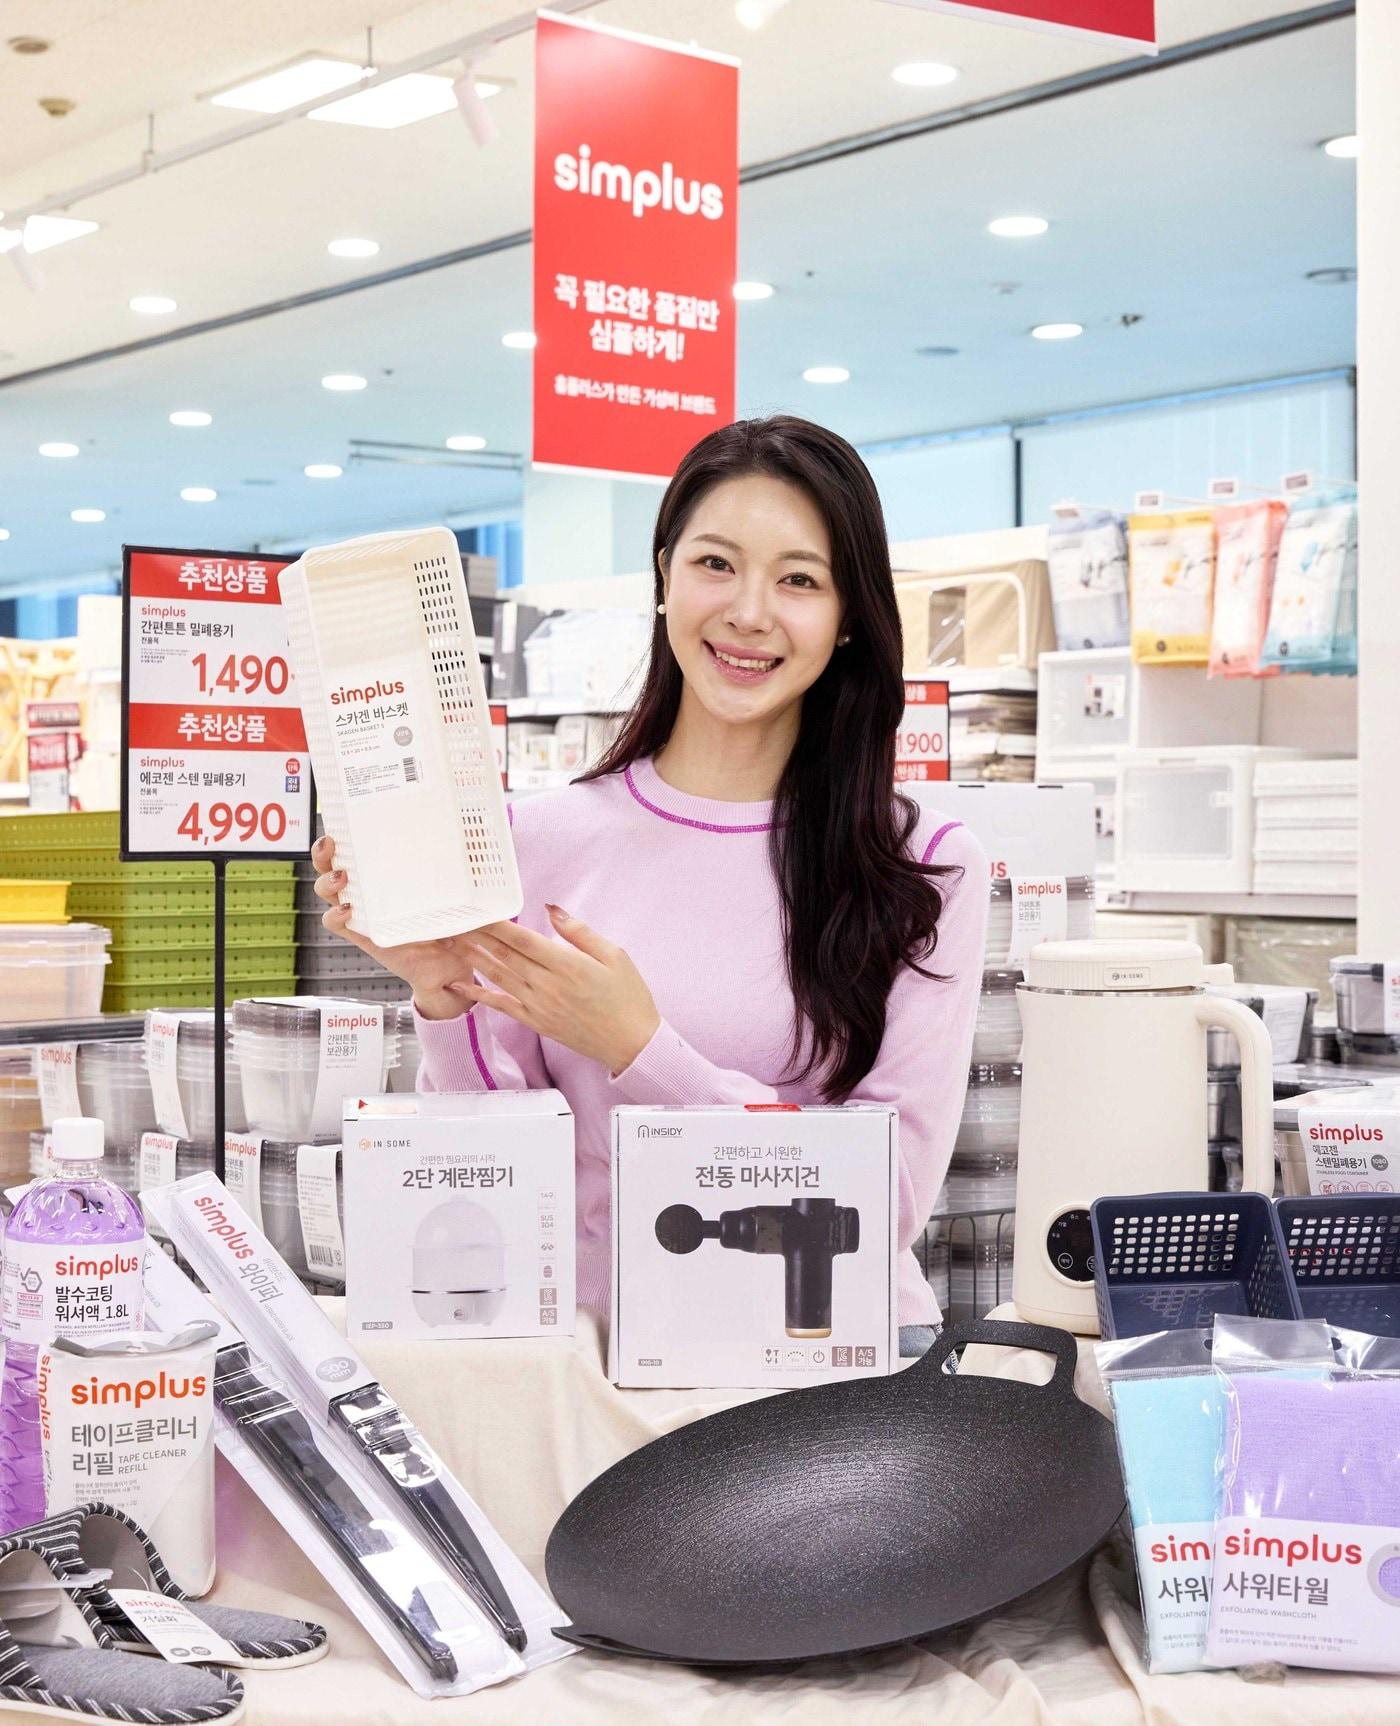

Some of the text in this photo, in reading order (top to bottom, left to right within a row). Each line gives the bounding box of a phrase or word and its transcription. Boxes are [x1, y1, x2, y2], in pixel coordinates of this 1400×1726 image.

[554, 144, 723, 219] simplus
[554, 273, 720, 332] 꼭 필요한 품질만
[589, 319, 685, 363] 심플하게!
[178, 562, 268, 595] 추천상품
[141, 604, 186, 620] simplus
[141, 620, 234, 638] 간편튼튼 밀폐용기
[191, 653, 288, 697] 1,490
[330, 680, 405, 705] simplus
[335, 702, 409, 727] 스카겐 바스켓
[177, 713, 268, 743] 추천상품
[140, 755, 185, 770] simplus
[140, 771, 246, 788] 에코젠 스텐 밀폐용기
[177, 802, 287, 846] 4,990
[1018, 881, 1062, 898] simplus
[327, 1013, 378, 1031] simplus
[327, 1033, 358, 1045] 간편튼튼
[327, 1045, 358, 1057] 보관용기
[373, 1139, 412, 1148] IN SOME
[1309, 1122, 1384, 1145] simplus
[224, 1138, 257, 1157] simplus
[713, 1146, 802, 1161] 간편하고 시원한
[1312, 1144, 1339, 1156] 에코젠
[420, 1154, 444, 1166] 간편한
[1315, 1157, 1367, 1169] 스텐밀폐용기
[402, 1166, 513, 1189] 2단 계란찜기
[695, 1165, 821, 1189] 전동 마사지건
[194, 1196, 254, 1260] simplus
[540, 1214, 554, 1222] SUS
[540, 1221, 554, 1229] 304
[55, 1253, 138, 1281] simplus
[238, 1263, 285, 1303] 와이퍼
[55, 1284, 113, 1304] 발수코팅
[857, 1348, 874, 1358] A/S
[38, 1354, 51, 1441] simplus
[71, 1371, 206, 1409] simplus
[71, 1416, 197, 1448] 테이프클리너
[72, 1451, 114, 1476] 리필
[118, 1448, 187, 1464] TAPE CLEANER
[118, 1463, 149, 1475] REFILL
[1224, 1528, 1363, 1567] simplus
[1222, 1570, 1329, 1606] 샤워타월
[1220, 1605, 1318, 1620] EXFOLIATING WASHCLOTH
